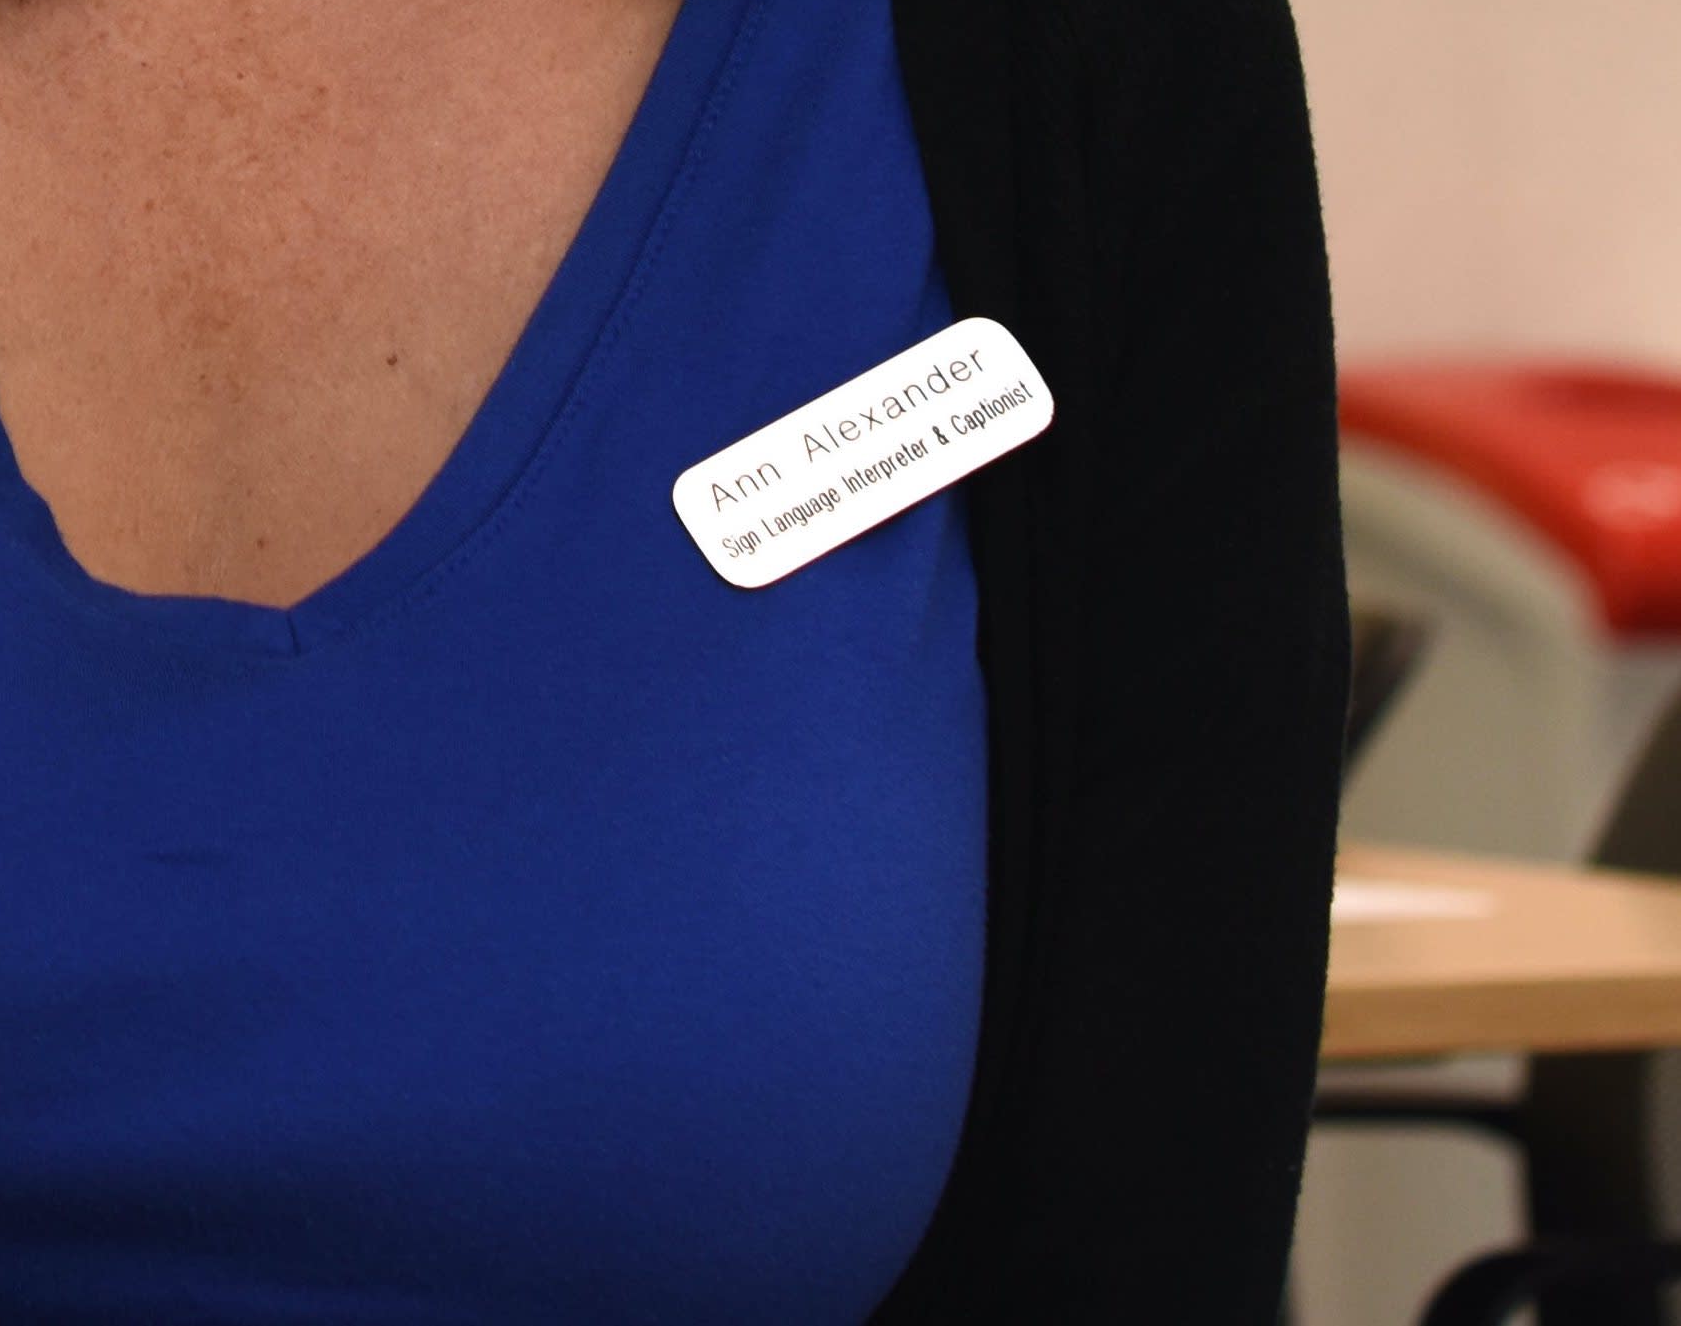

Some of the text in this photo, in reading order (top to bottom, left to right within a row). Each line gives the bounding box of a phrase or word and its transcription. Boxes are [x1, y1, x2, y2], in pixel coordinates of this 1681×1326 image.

[710, 349, 985, 512] Ann Alexander
[722, 379, 1034, 559] Sign Language Interpreter & Captionist
